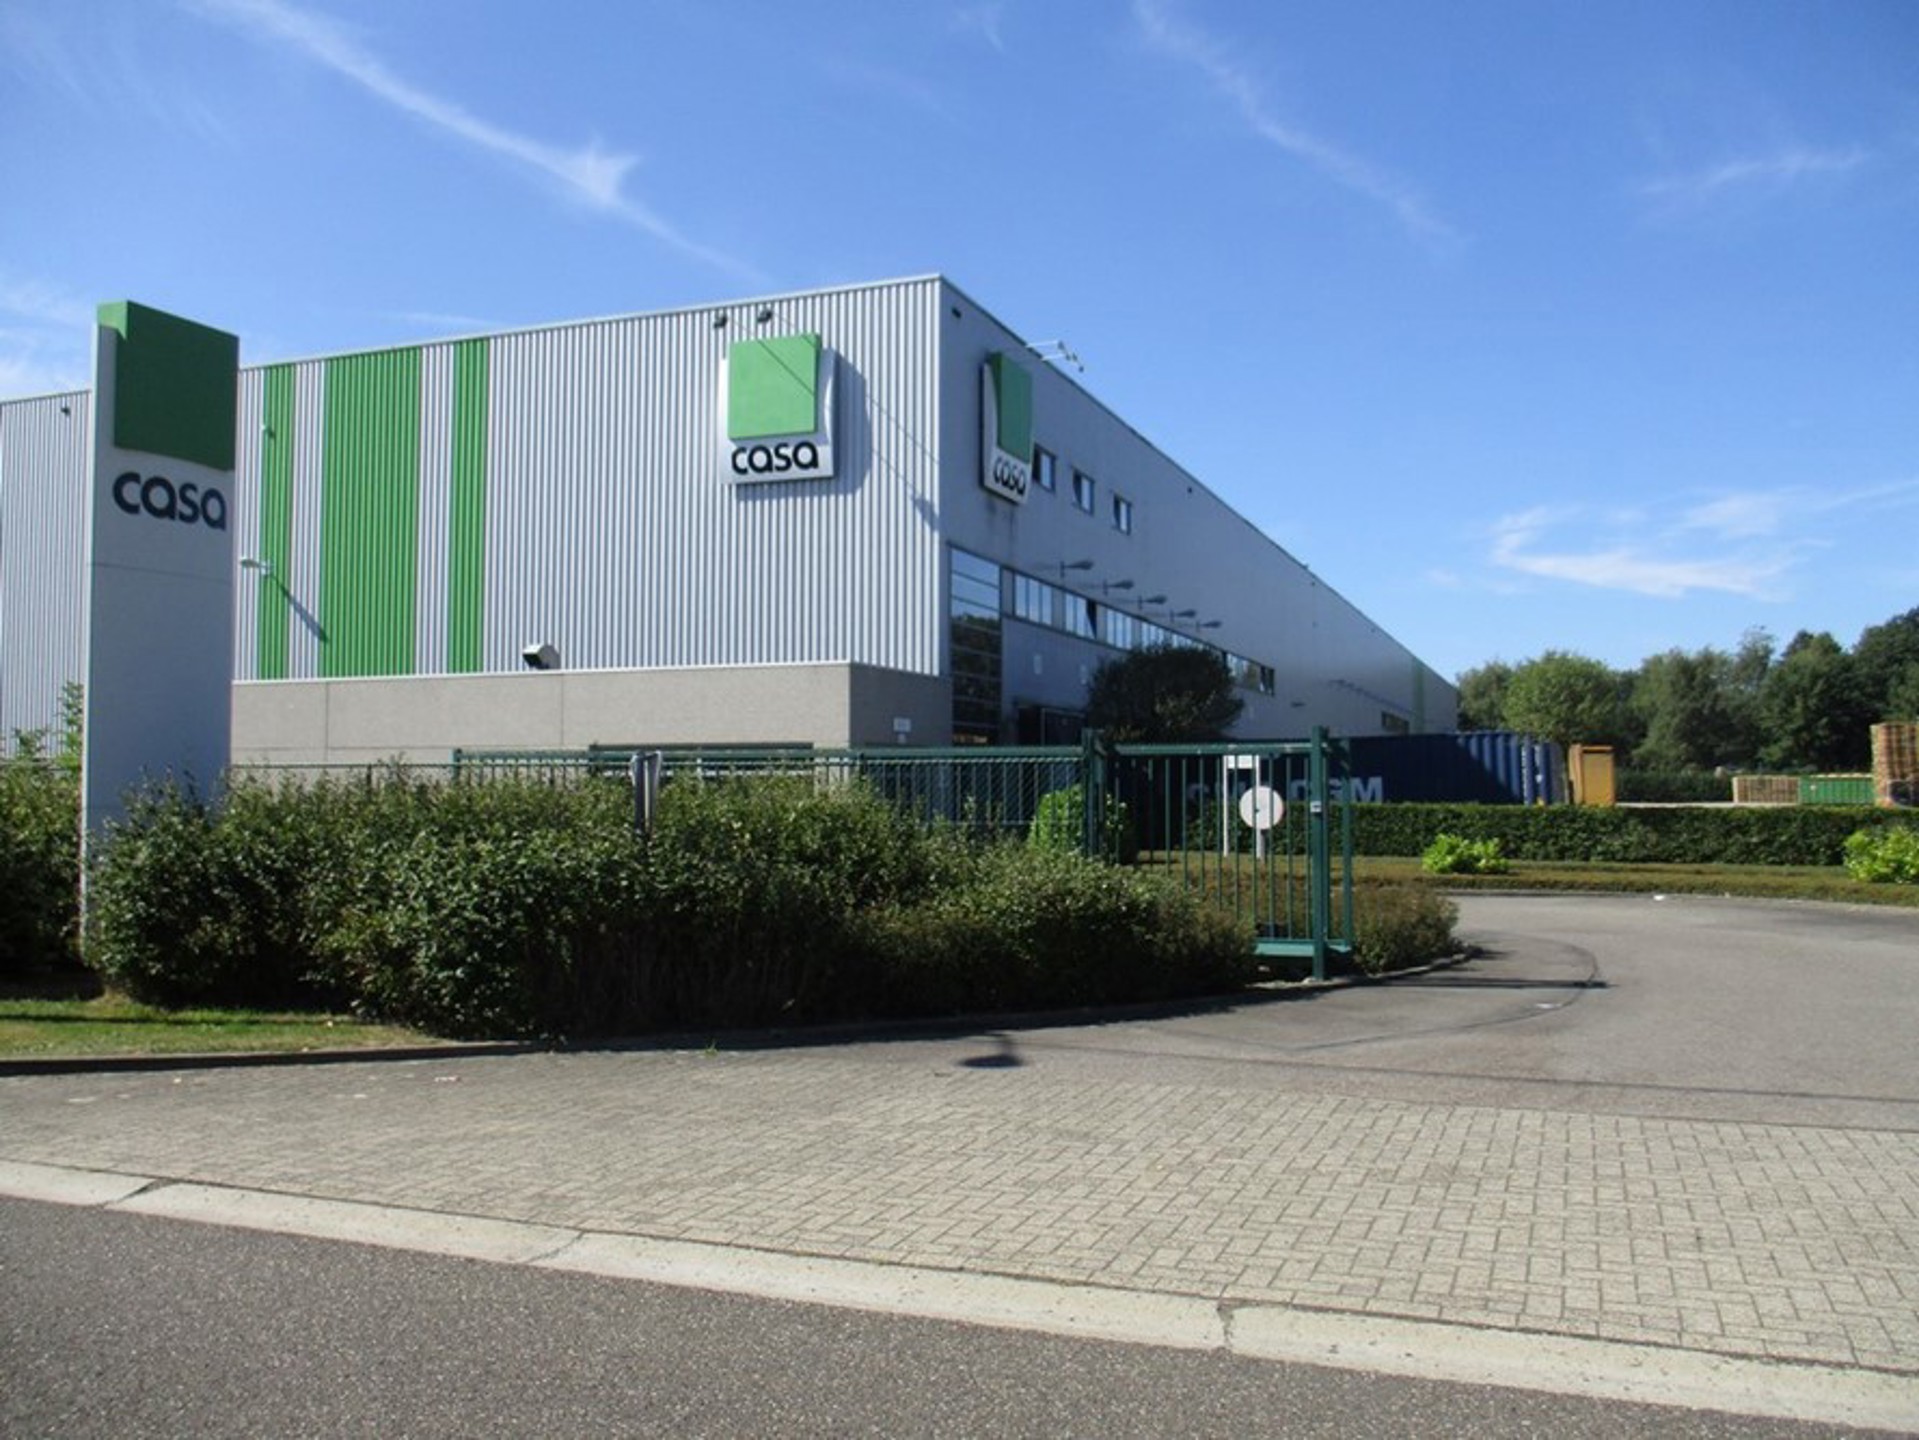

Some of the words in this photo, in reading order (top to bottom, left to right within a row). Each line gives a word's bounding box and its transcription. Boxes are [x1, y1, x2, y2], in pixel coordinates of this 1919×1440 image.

[732, 441, 819, 475] casa
[993, 456, 1026, 496] casa
[113, 472, 227, 531] casa
